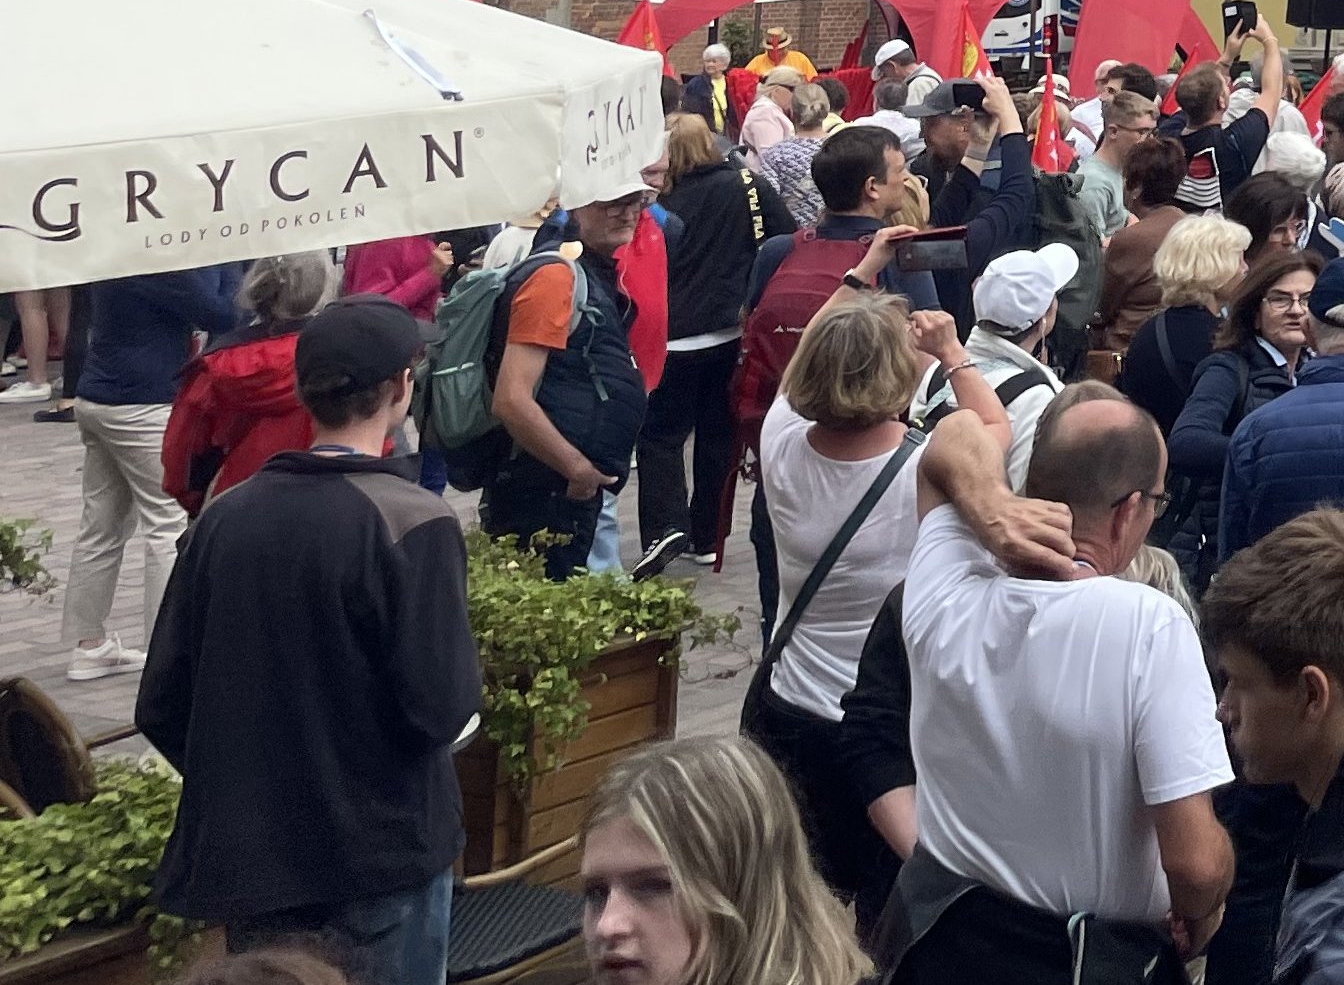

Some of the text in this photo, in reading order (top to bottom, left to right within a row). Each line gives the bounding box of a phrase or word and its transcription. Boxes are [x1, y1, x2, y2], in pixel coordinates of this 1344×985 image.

[145, 204, 367, 248] LODY OD POKOLEŃ
